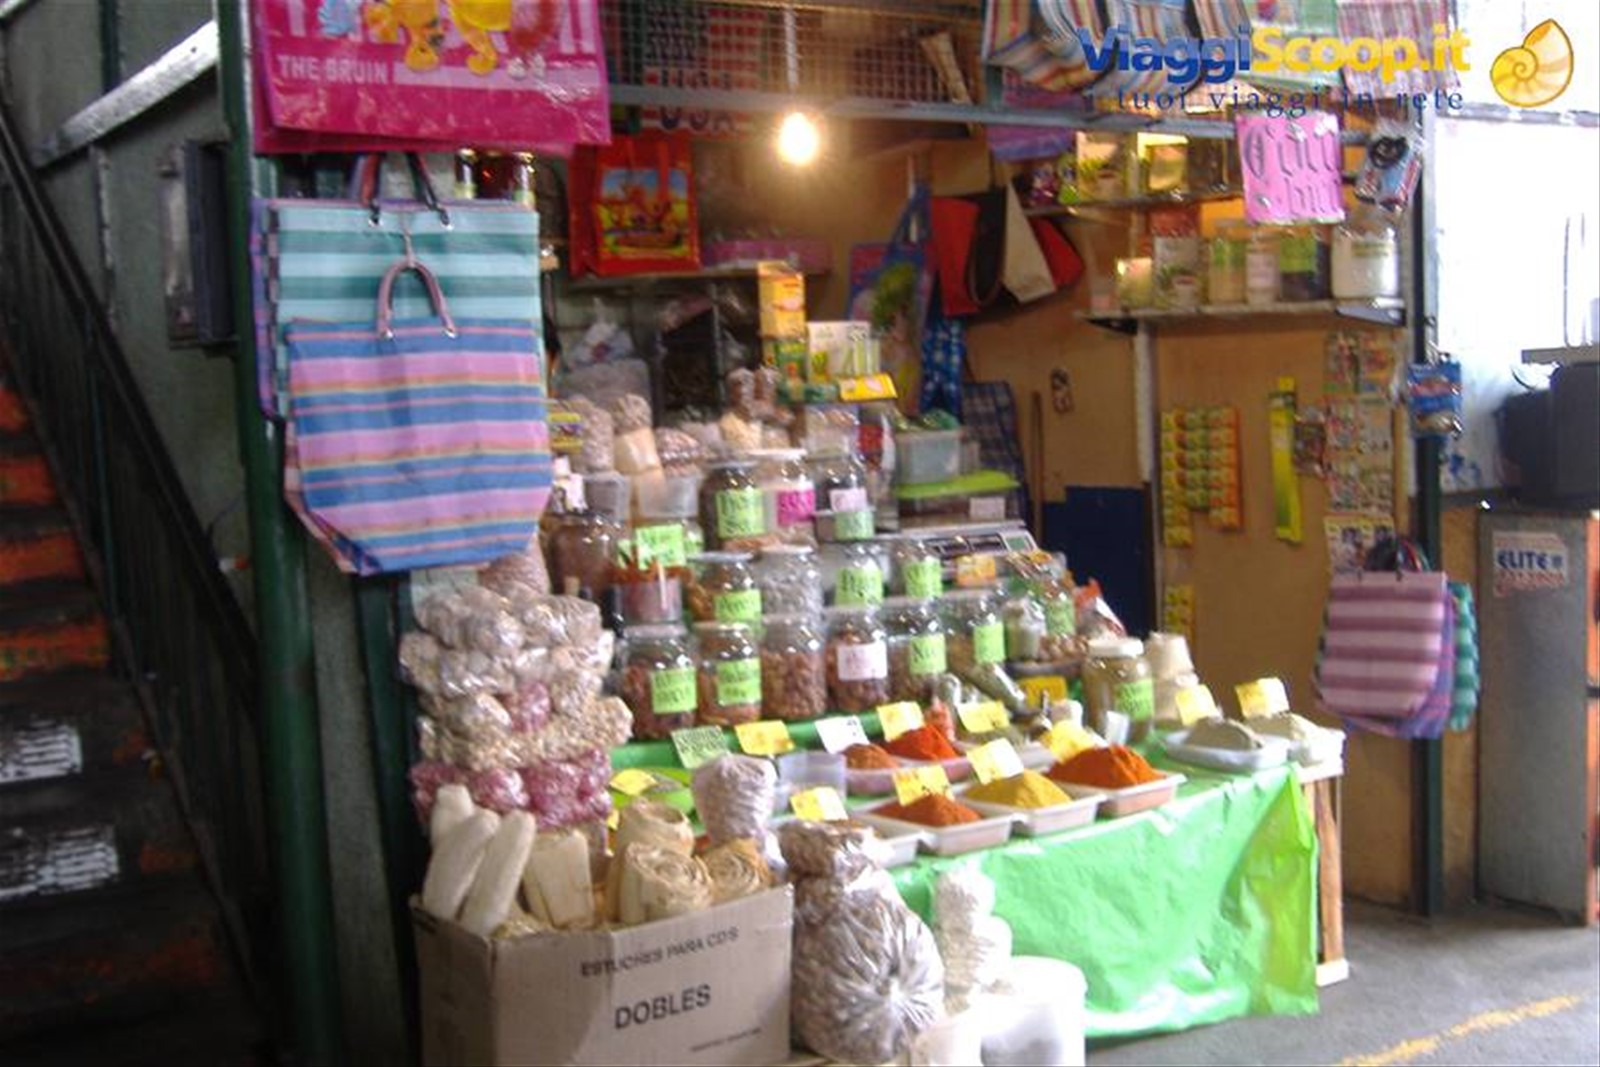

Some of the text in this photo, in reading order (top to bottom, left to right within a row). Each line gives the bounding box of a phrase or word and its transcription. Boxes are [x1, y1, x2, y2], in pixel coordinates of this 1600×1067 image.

[278, 54, 389, 84] THE BRUIN
[1496, 549, 1549, 570] ELITE
[614, 983, 711, 1030] DOBLES
